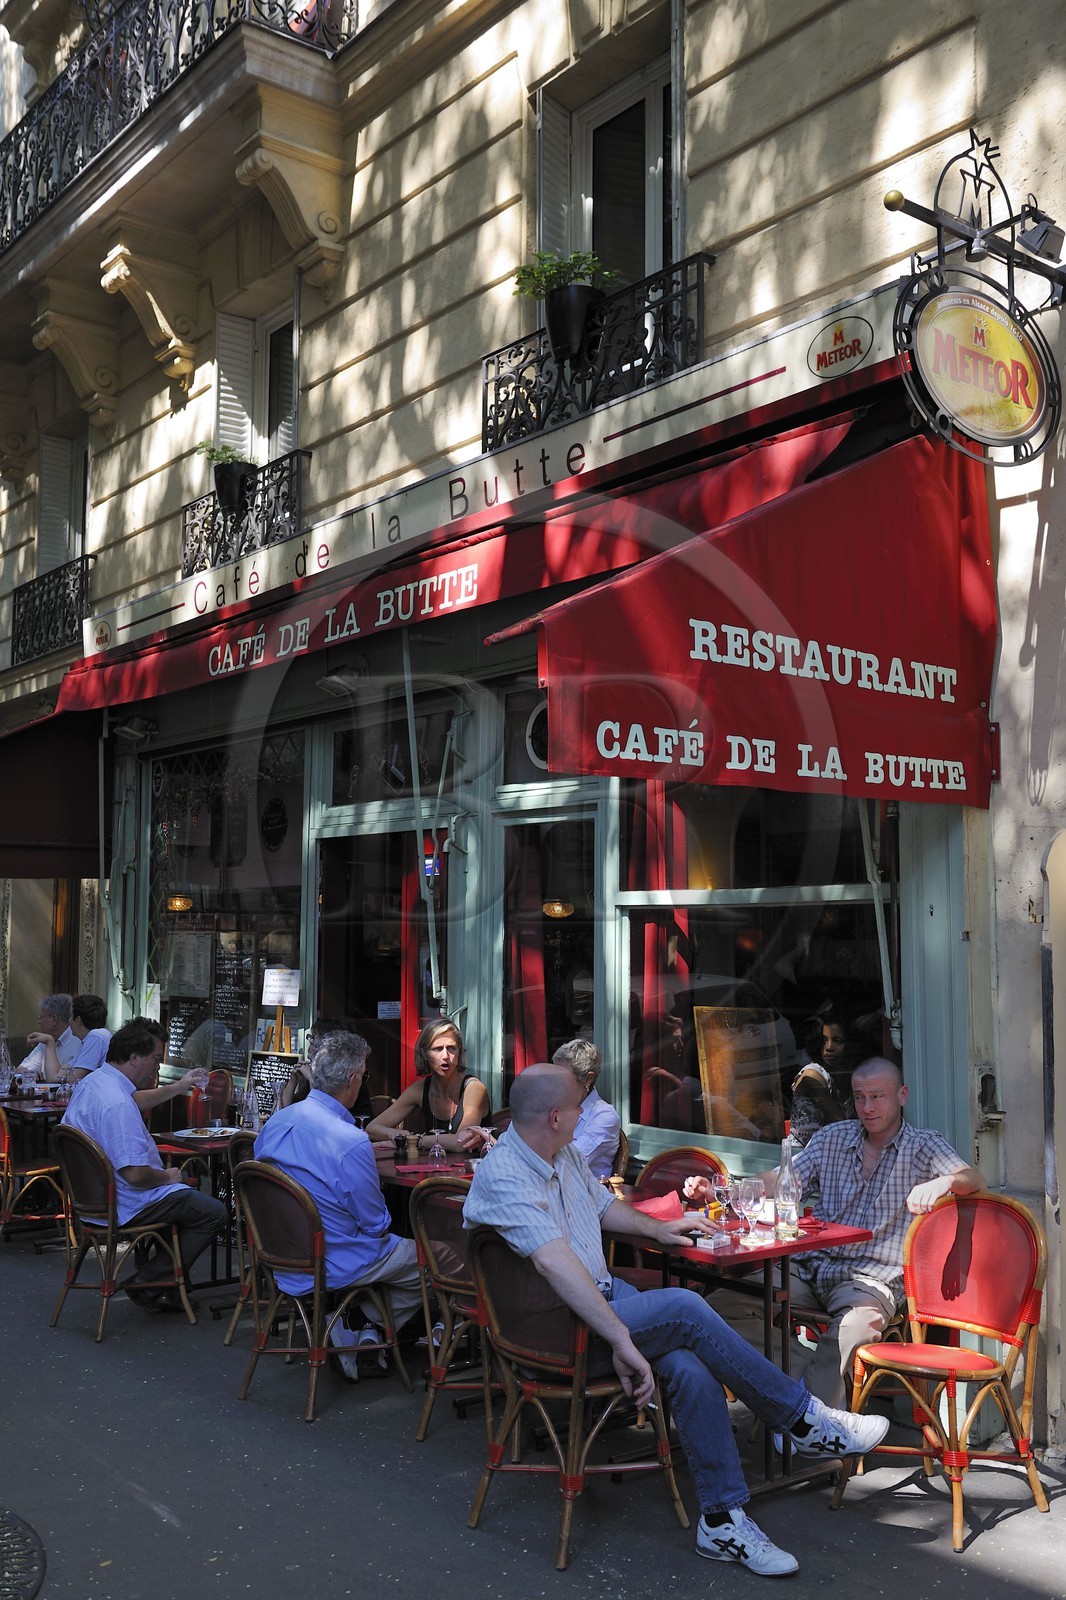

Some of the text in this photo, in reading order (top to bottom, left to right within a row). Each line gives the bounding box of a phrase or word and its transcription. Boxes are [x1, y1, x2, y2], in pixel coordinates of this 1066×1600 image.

[816, 338, 863, 371] METEOR
[833, 330, 845, 346] M
[971, 298, 990, 313] Alsace
[990, 307, 1009, 327] depuis
[1009, 324, 1023, 342] 1640
[973, 325, 987, 349] M
[932, 327, 1034, 410] METEOR
[194, 442, 586, 614] Café de la Butte
[208, 563, 479, 677] CAFÉ DE LA BUTTE
[688, 618, 957, 704] RESTAURANT
[596, 718, 967, 791] CAFÉ DE LA BUTTE
